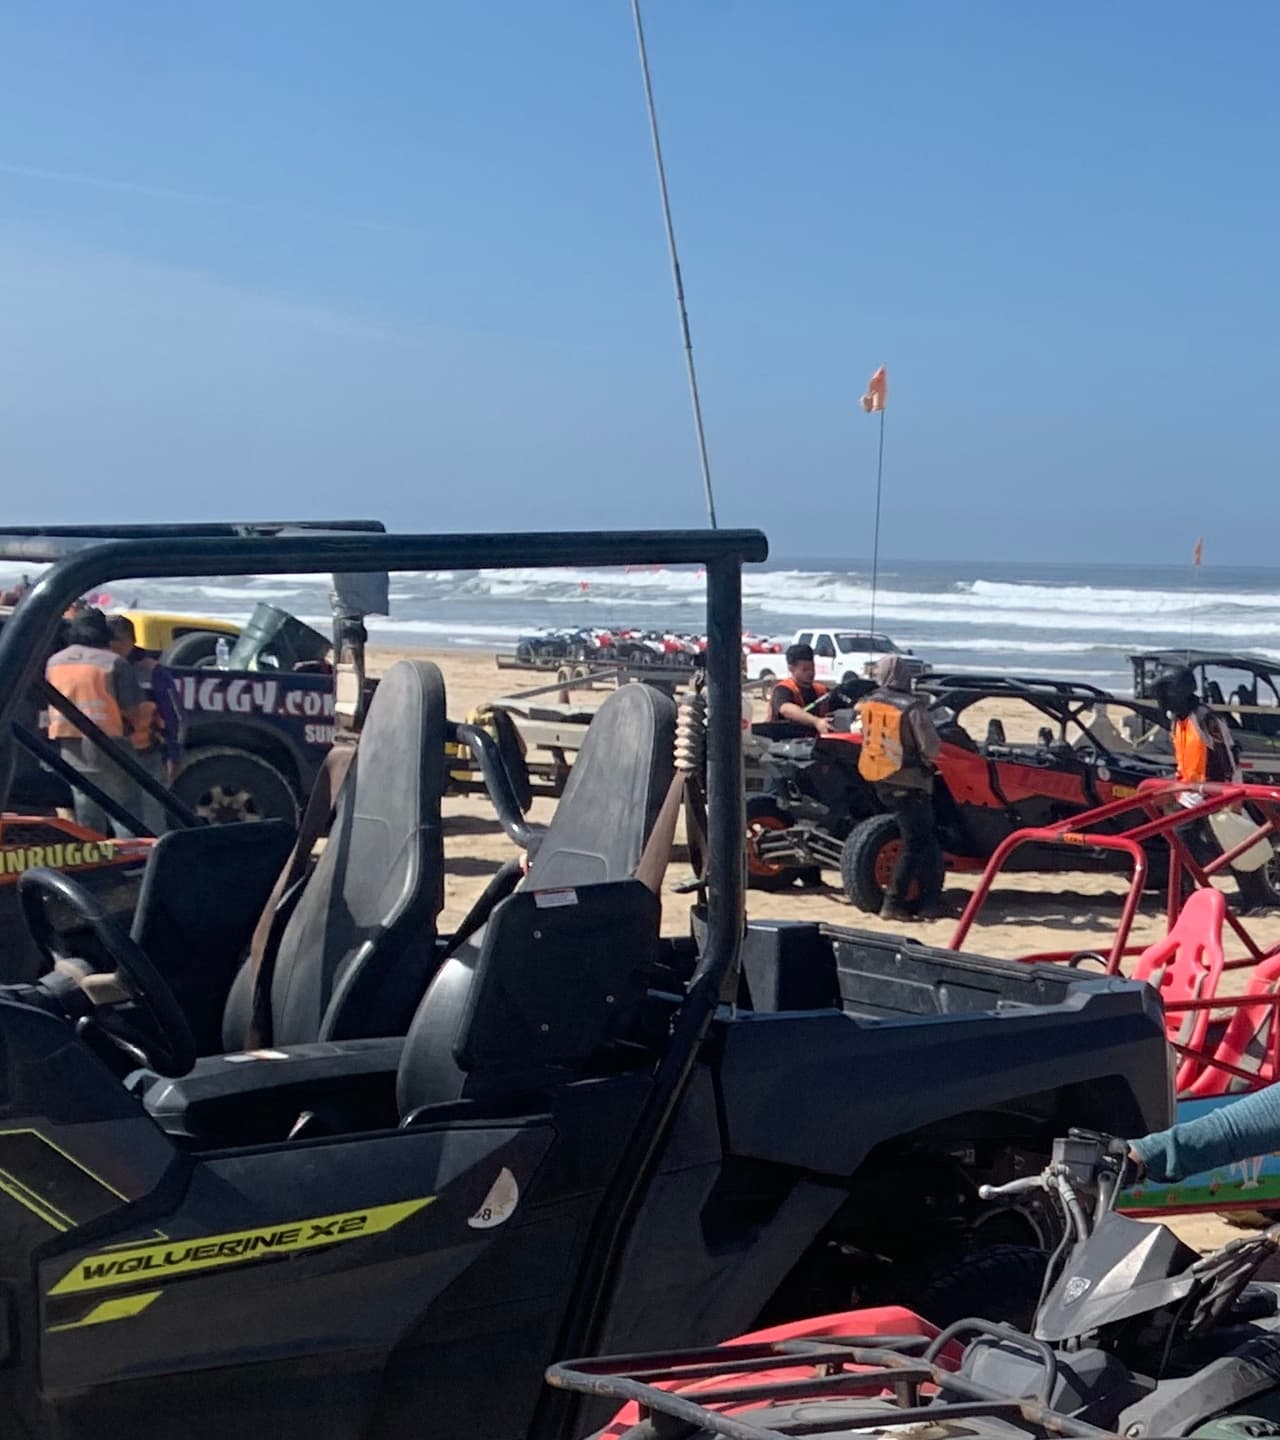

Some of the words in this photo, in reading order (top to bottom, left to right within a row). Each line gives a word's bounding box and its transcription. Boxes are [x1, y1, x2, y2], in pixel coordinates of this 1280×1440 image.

[0, 842, 115, 874] NBUGGY
[83, 1228, 302, 1281] WOLVERINE
[306, 1215, 368, 1241] X2
